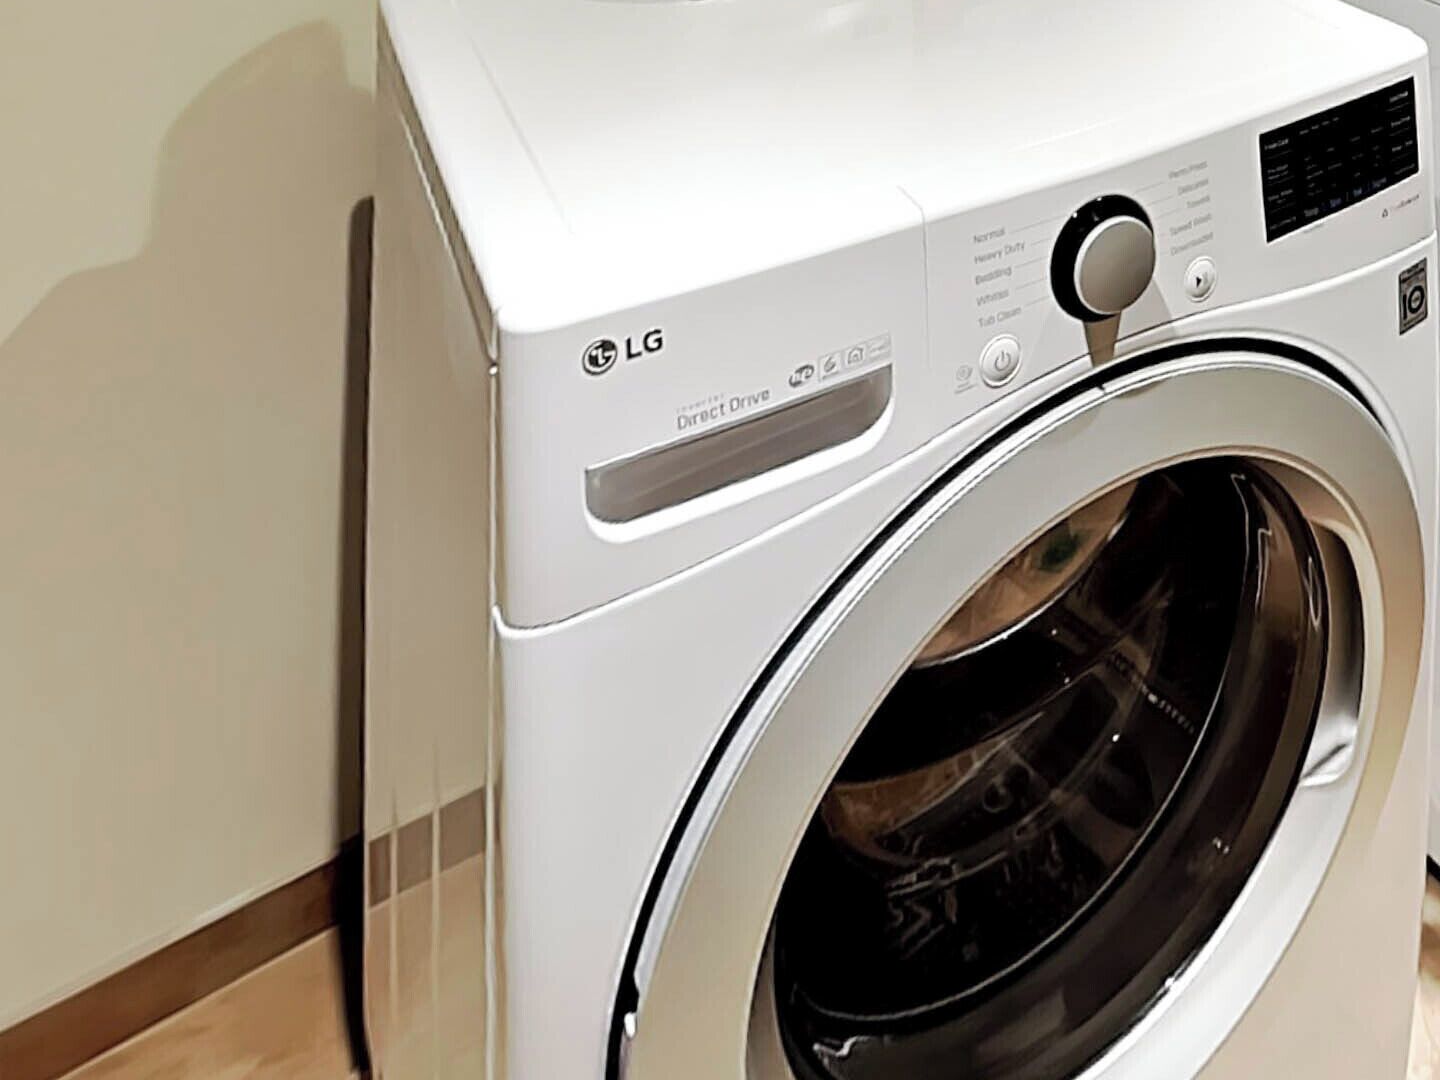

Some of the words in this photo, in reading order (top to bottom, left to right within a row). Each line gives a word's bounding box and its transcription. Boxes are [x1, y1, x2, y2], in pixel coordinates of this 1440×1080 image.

[625, 328, 663, 360] LG
[677, 403, 725, 430] Direct
[729, 389, 770, 413] Drive
